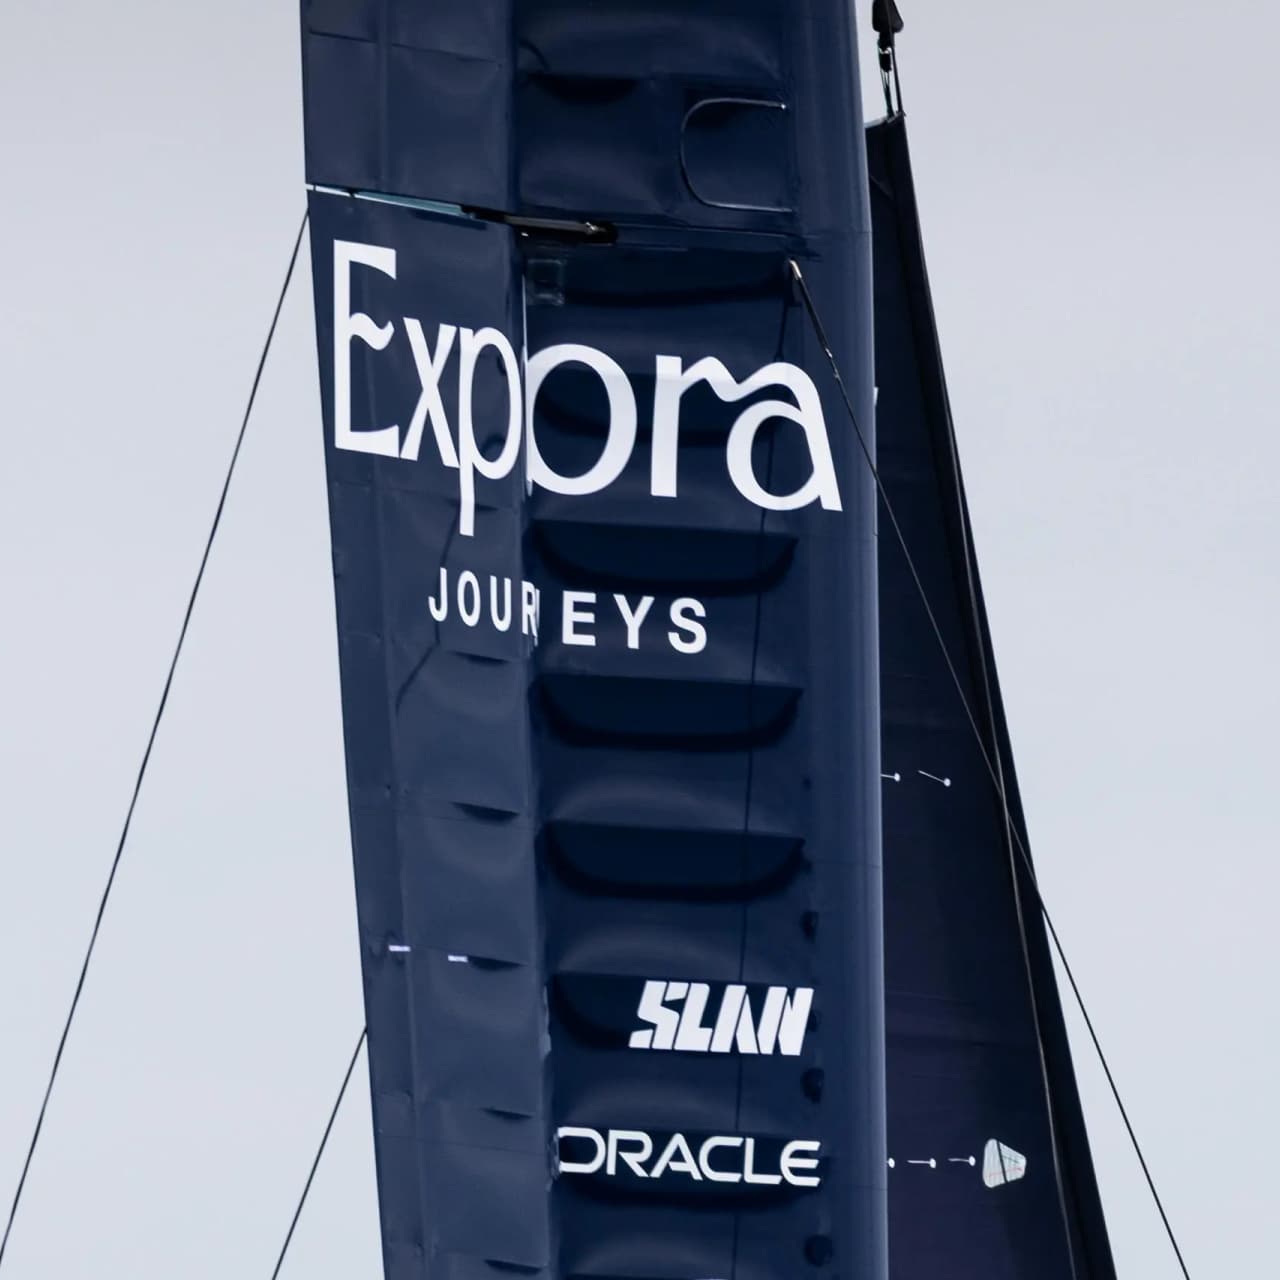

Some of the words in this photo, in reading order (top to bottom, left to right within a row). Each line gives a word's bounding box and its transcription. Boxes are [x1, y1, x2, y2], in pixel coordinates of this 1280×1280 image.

[332, 238, 843, 537] Expora
[427, 566, 708, 655] JOUREYS
[557, 1126, 821, 1188] ORACLE
